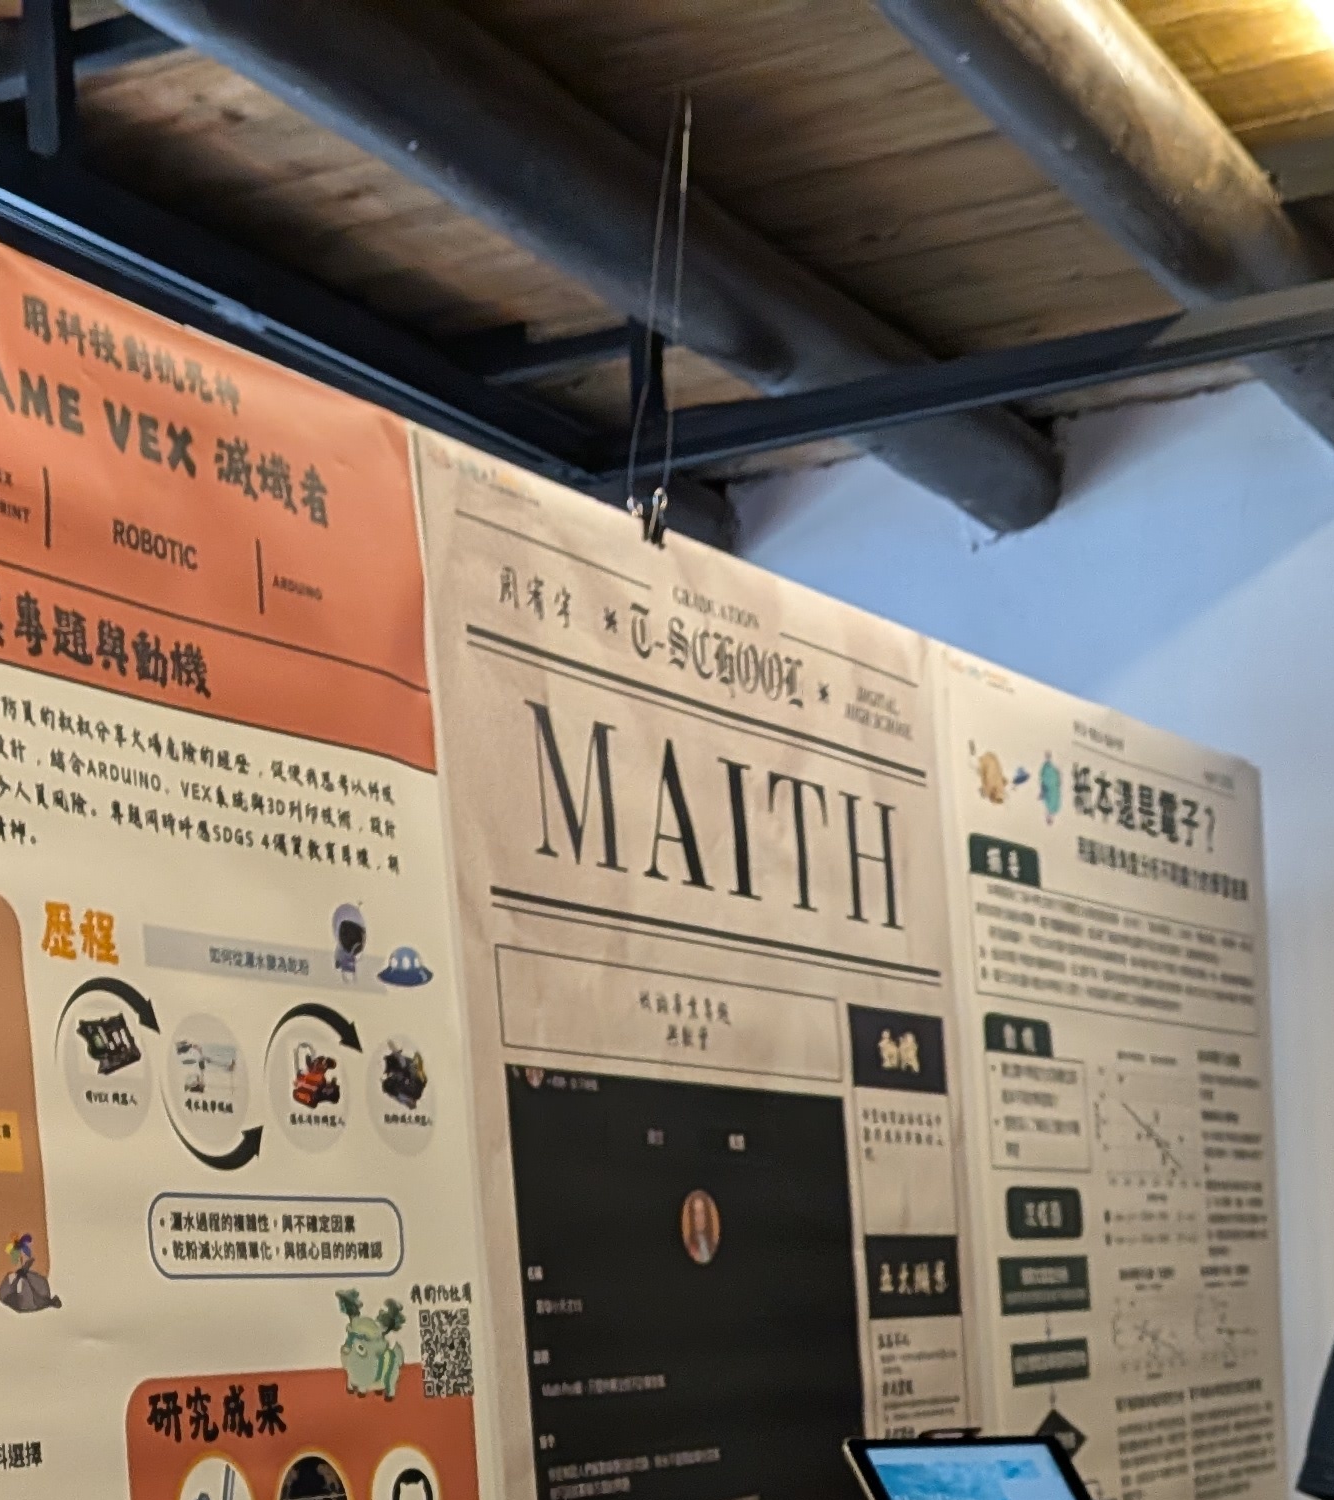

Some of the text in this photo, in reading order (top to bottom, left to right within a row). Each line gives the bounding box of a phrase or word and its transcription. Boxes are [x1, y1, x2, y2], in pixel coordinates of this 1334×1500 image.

[103, 399, 197, 478] VEX
[112, 518, 198, 571] ROBOTIC
[524, 699, 905, 931] MAITH
[41, 900, 119, 965] 歷程
[147, 1383, 287, 1443] 研究成果
